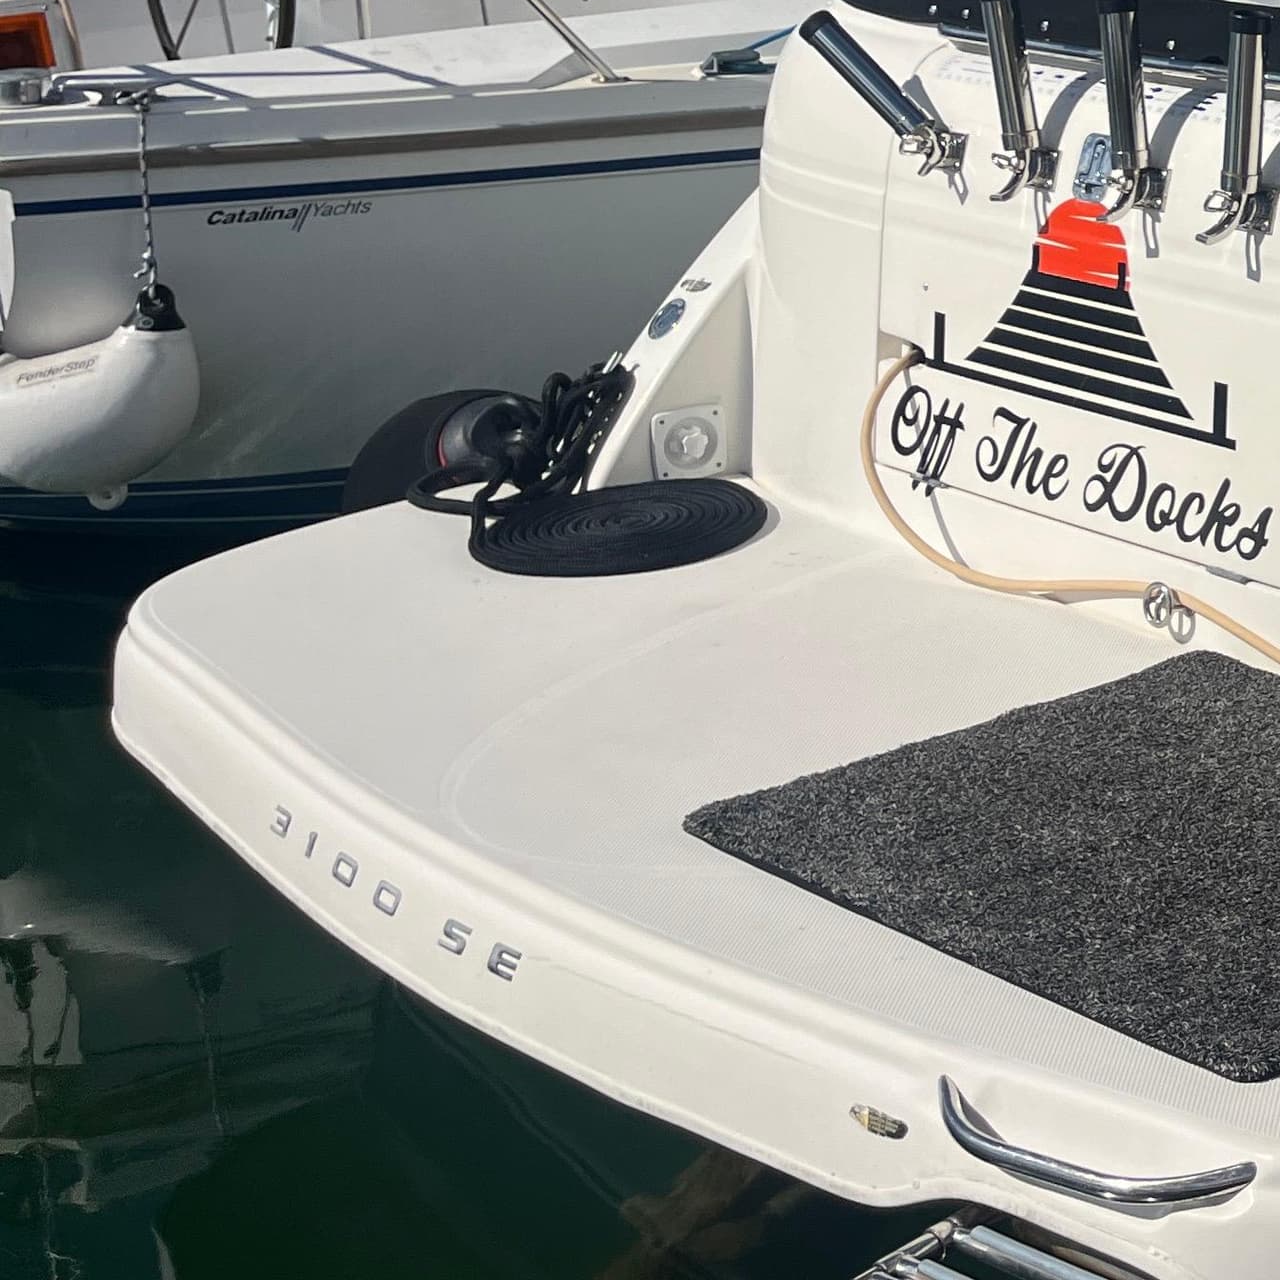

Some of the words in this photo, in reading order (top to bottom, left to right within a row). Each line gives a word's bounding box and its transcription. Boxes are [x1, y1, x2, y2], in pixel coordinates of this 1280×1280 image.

[206, 204, 299, 226] Catalina
[312, 199, 373, 218] Yachts
[891, 384, 966, 497] Off
[975, 406, 1070, 501] The
[1082, 442, 1274, 561] Docks
[269, 803, 403, 917] 3100
[437, 917, 523, 982] SE
